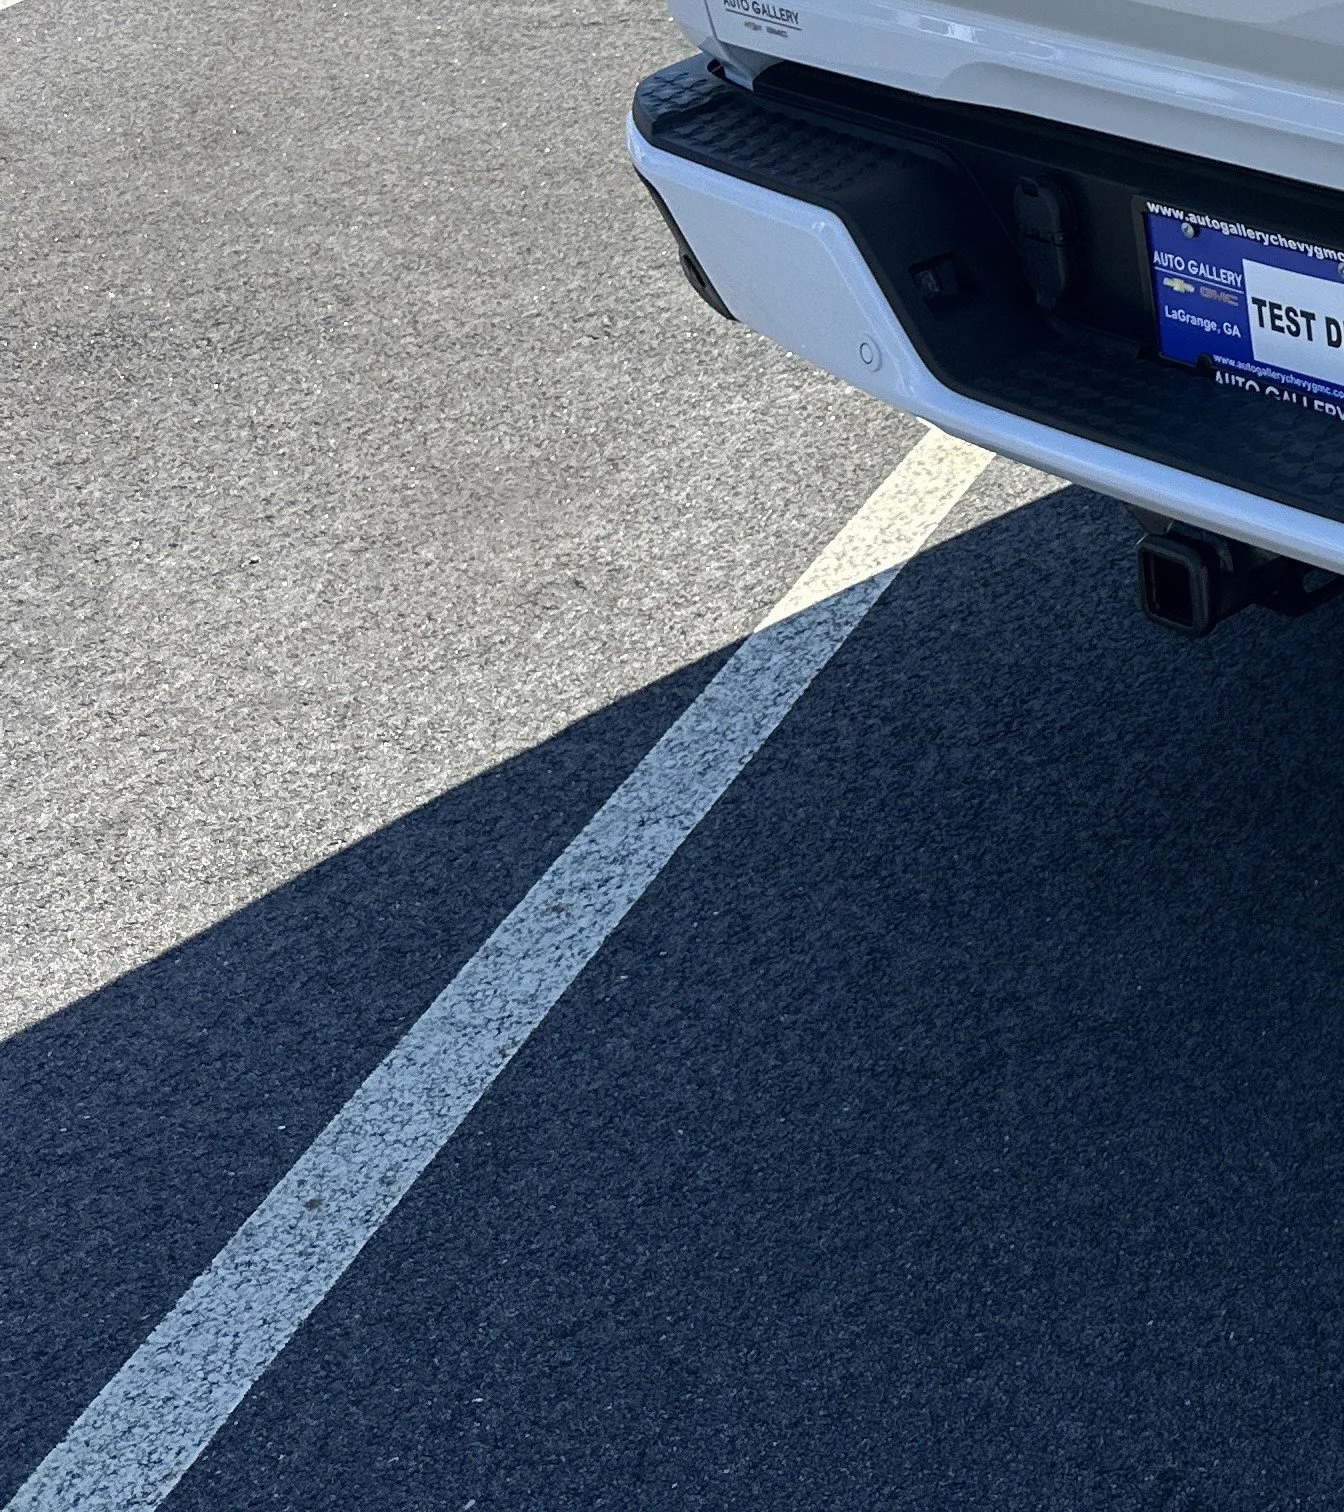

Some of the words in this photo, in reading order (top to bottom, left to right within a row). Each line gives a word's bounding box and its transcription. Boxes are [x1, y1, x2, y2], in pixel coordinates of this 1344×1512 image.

[751, 1, 799, 25] GALLERY
[1153, 250, 1185, 271] AUTO
[1188, 259, 1243, 288] GALLERY
[1200, 286, 1239, 306] GMC
[1164, 305, 1221, 334] LaGrange,
[1223, 322, 1242, 338] GA
[1251, 296, 1316, 342] TEST
